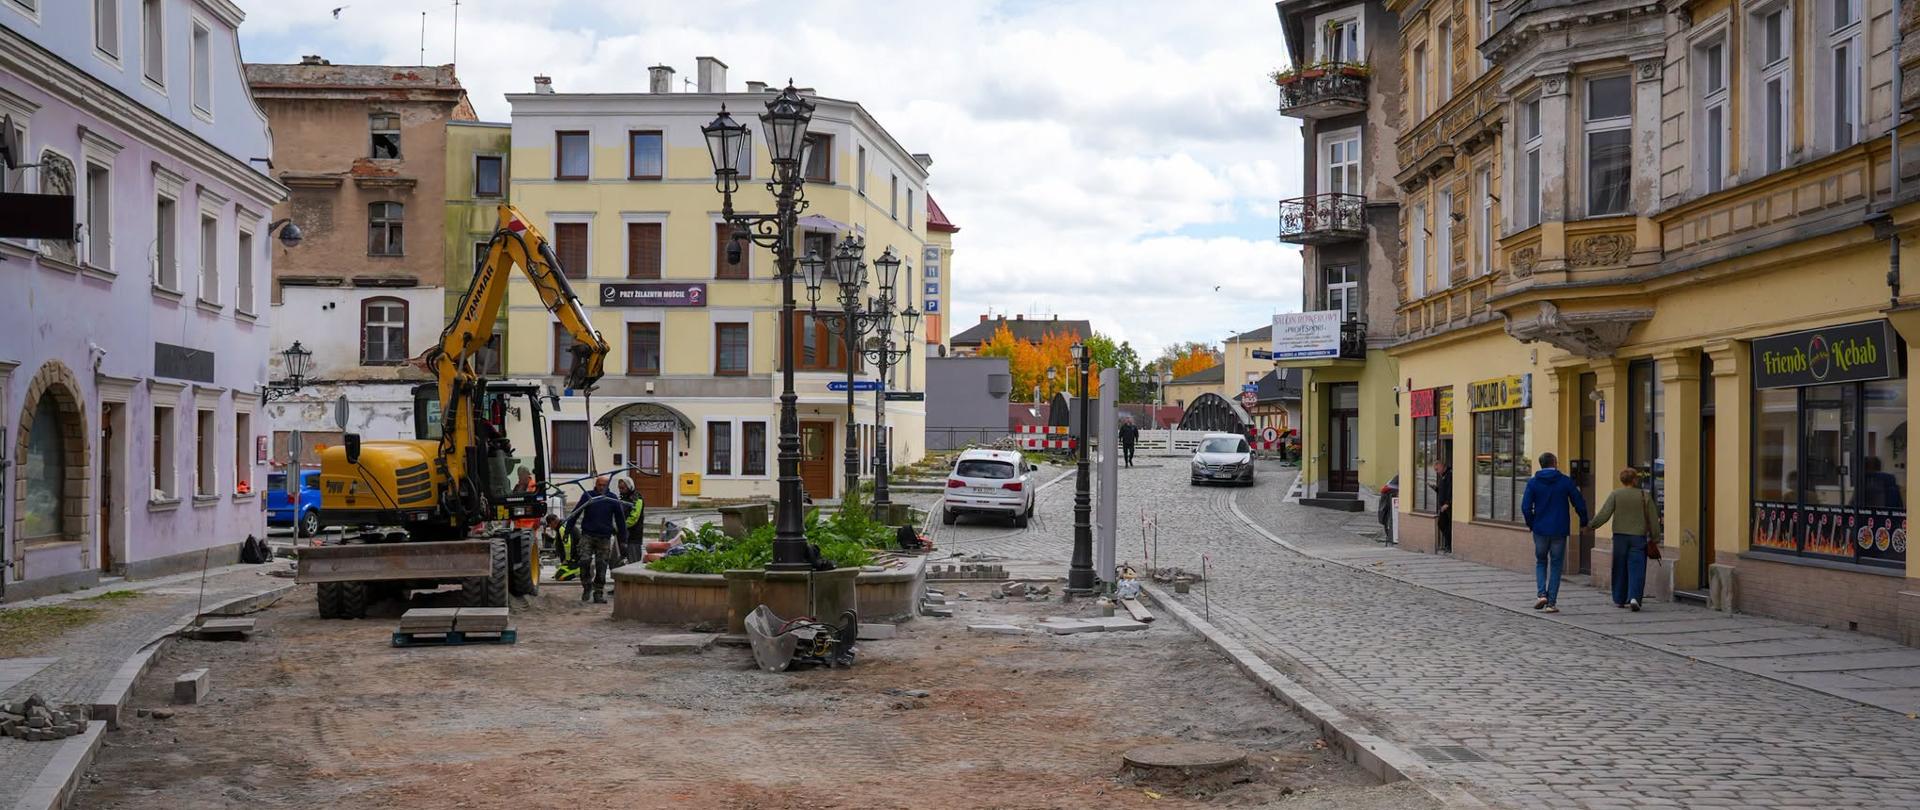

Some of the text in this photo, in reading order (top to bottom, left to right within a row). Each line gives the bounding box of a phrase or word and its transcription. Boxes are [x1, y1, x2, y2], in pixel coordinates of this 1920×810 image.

[464, 264, 494, 322] YANMAR
[619, 290, 634, 298] PRZY
[663, 289, 685, 298] MOŚCIE
[1763, 337, 1877, 375] Friends Kebab
